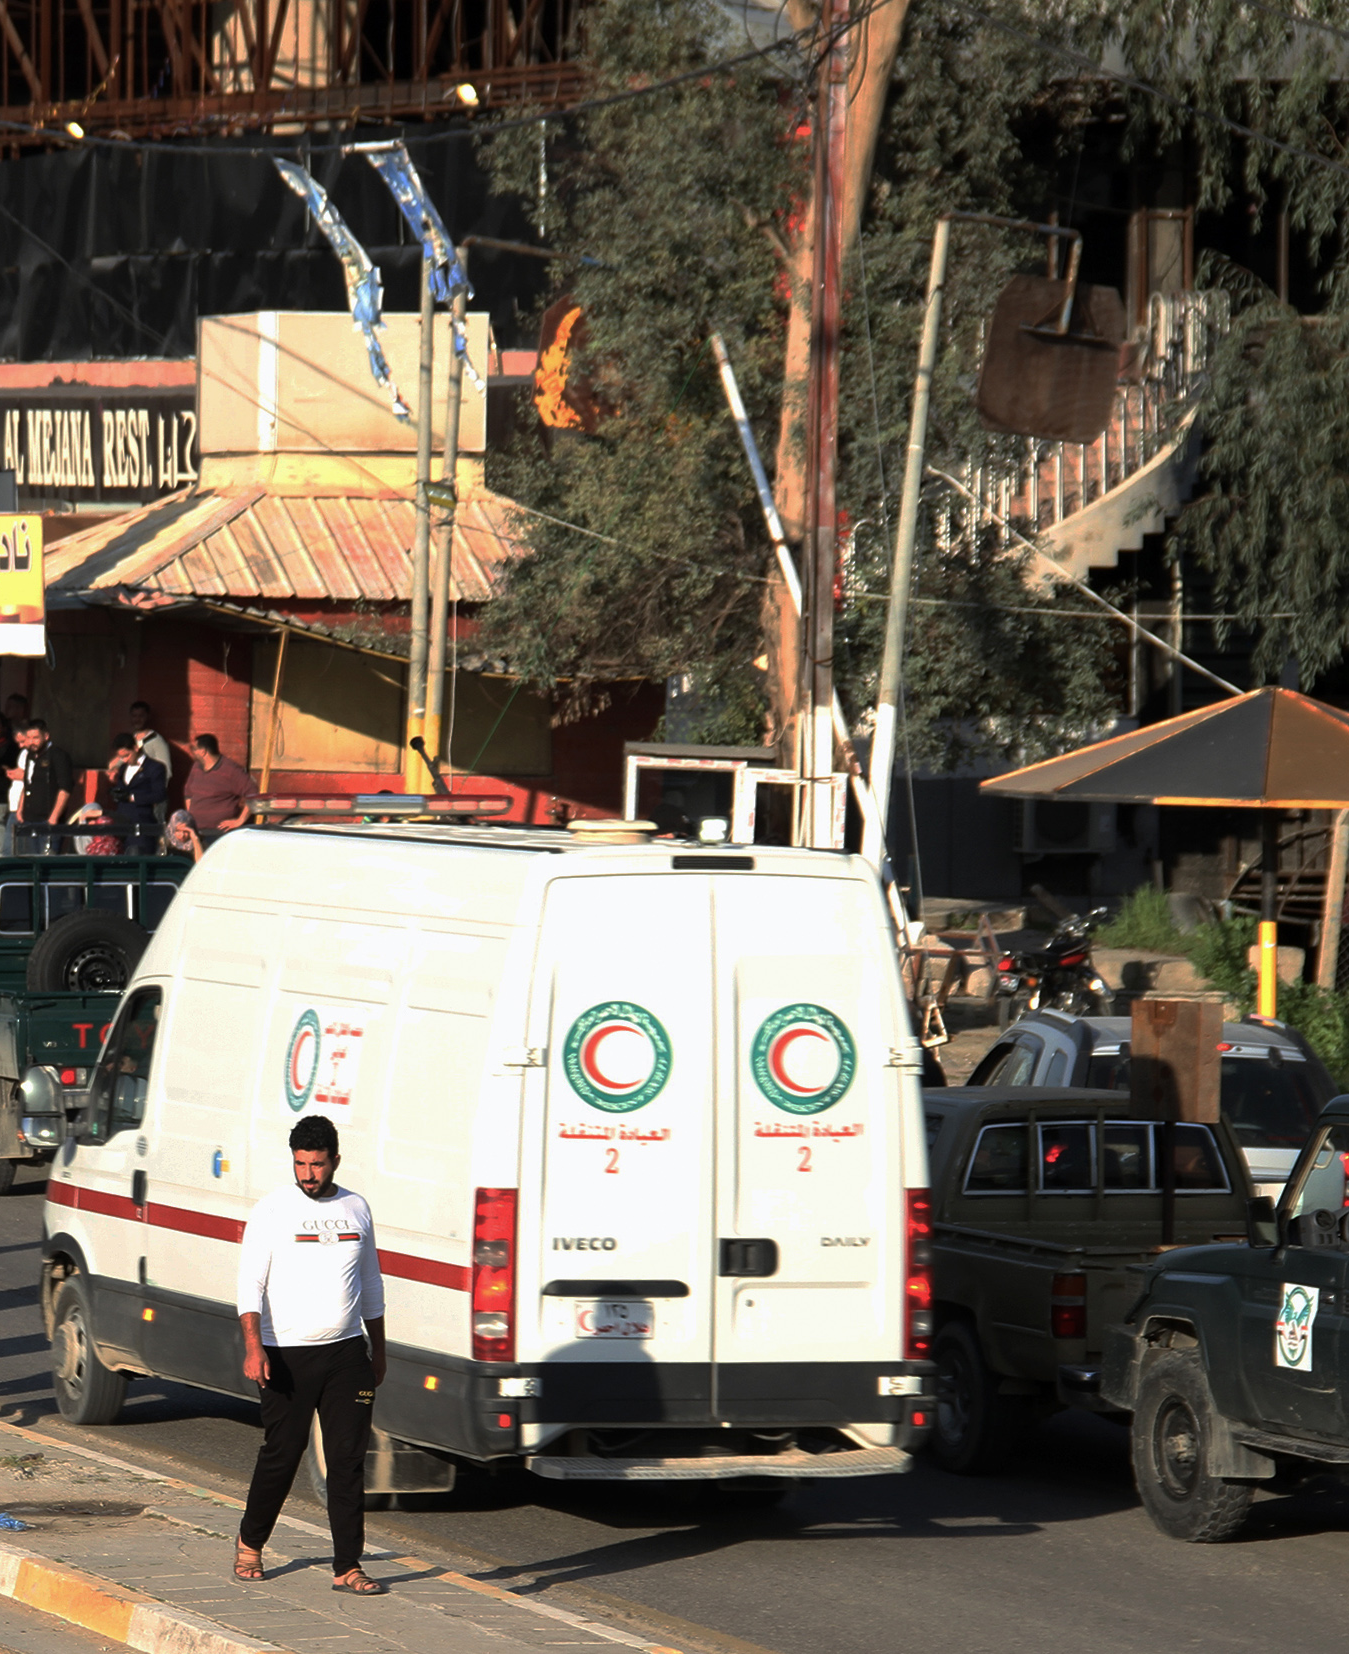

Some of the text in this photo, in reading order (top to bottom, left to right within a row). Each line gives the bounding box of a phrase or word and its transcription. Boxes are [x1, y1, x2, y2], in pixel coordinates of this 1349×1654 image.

[4, 410, 25, 485] AL
[27, 410, 95, 487] MEJANA
[619, 1123, 671, 1146] العيادة
[812, 1120, 864, 1143] العيادة
[605, 1147, 620, 1174] 2
[797, 1145, 812, 1172] 2
[302, 1219, 350, 1230] GUCCI
[552, 1237, 617, 1251] IVECO
[821, 1236, 871, 1247] DAILY
